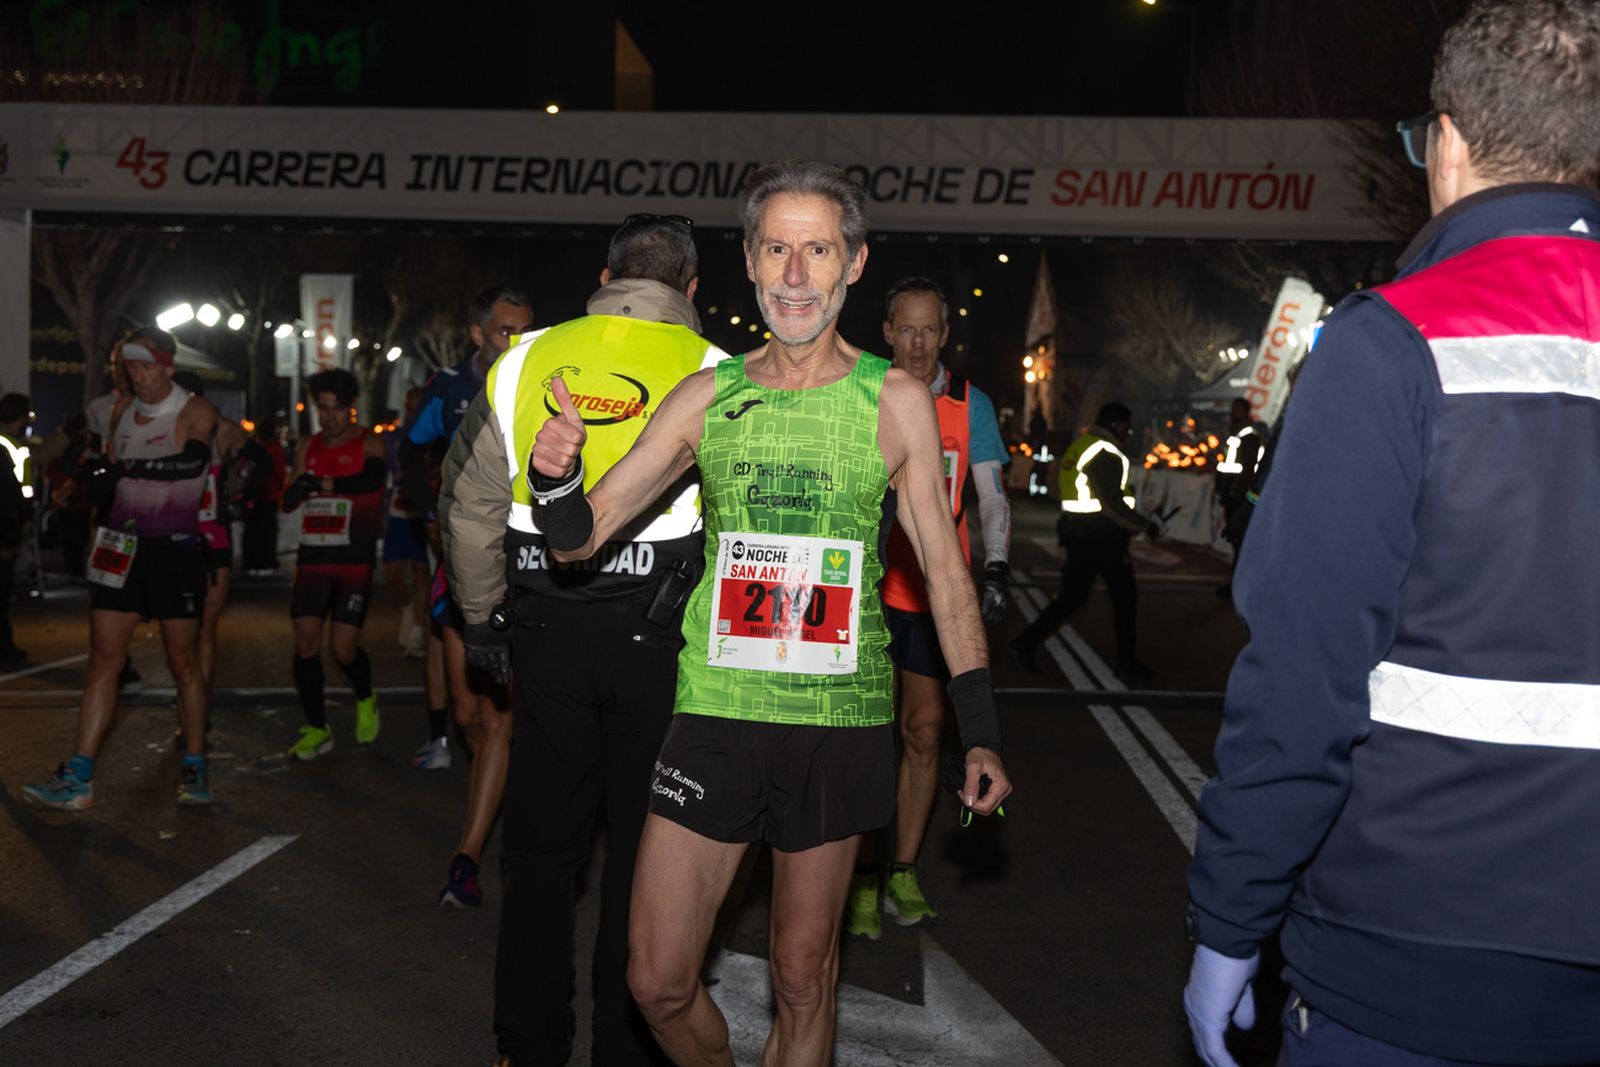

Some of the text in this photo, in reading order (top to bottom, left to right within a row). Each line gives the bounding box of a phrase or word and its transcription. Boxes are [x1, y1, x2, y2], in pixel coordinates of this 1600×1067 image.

[117, 137, 1316, 212] 43 CARRERA INTERNACIONA OCHE DE SAN ANTÓN
[733, 462, 834, 491] CD Trail Running
[747, 484, 813, 511] Cazorla
[746, 548, 788, 563] NOCHE
[730, 563, 757, 579] SAN
[671, 769, 705, 800] Running
